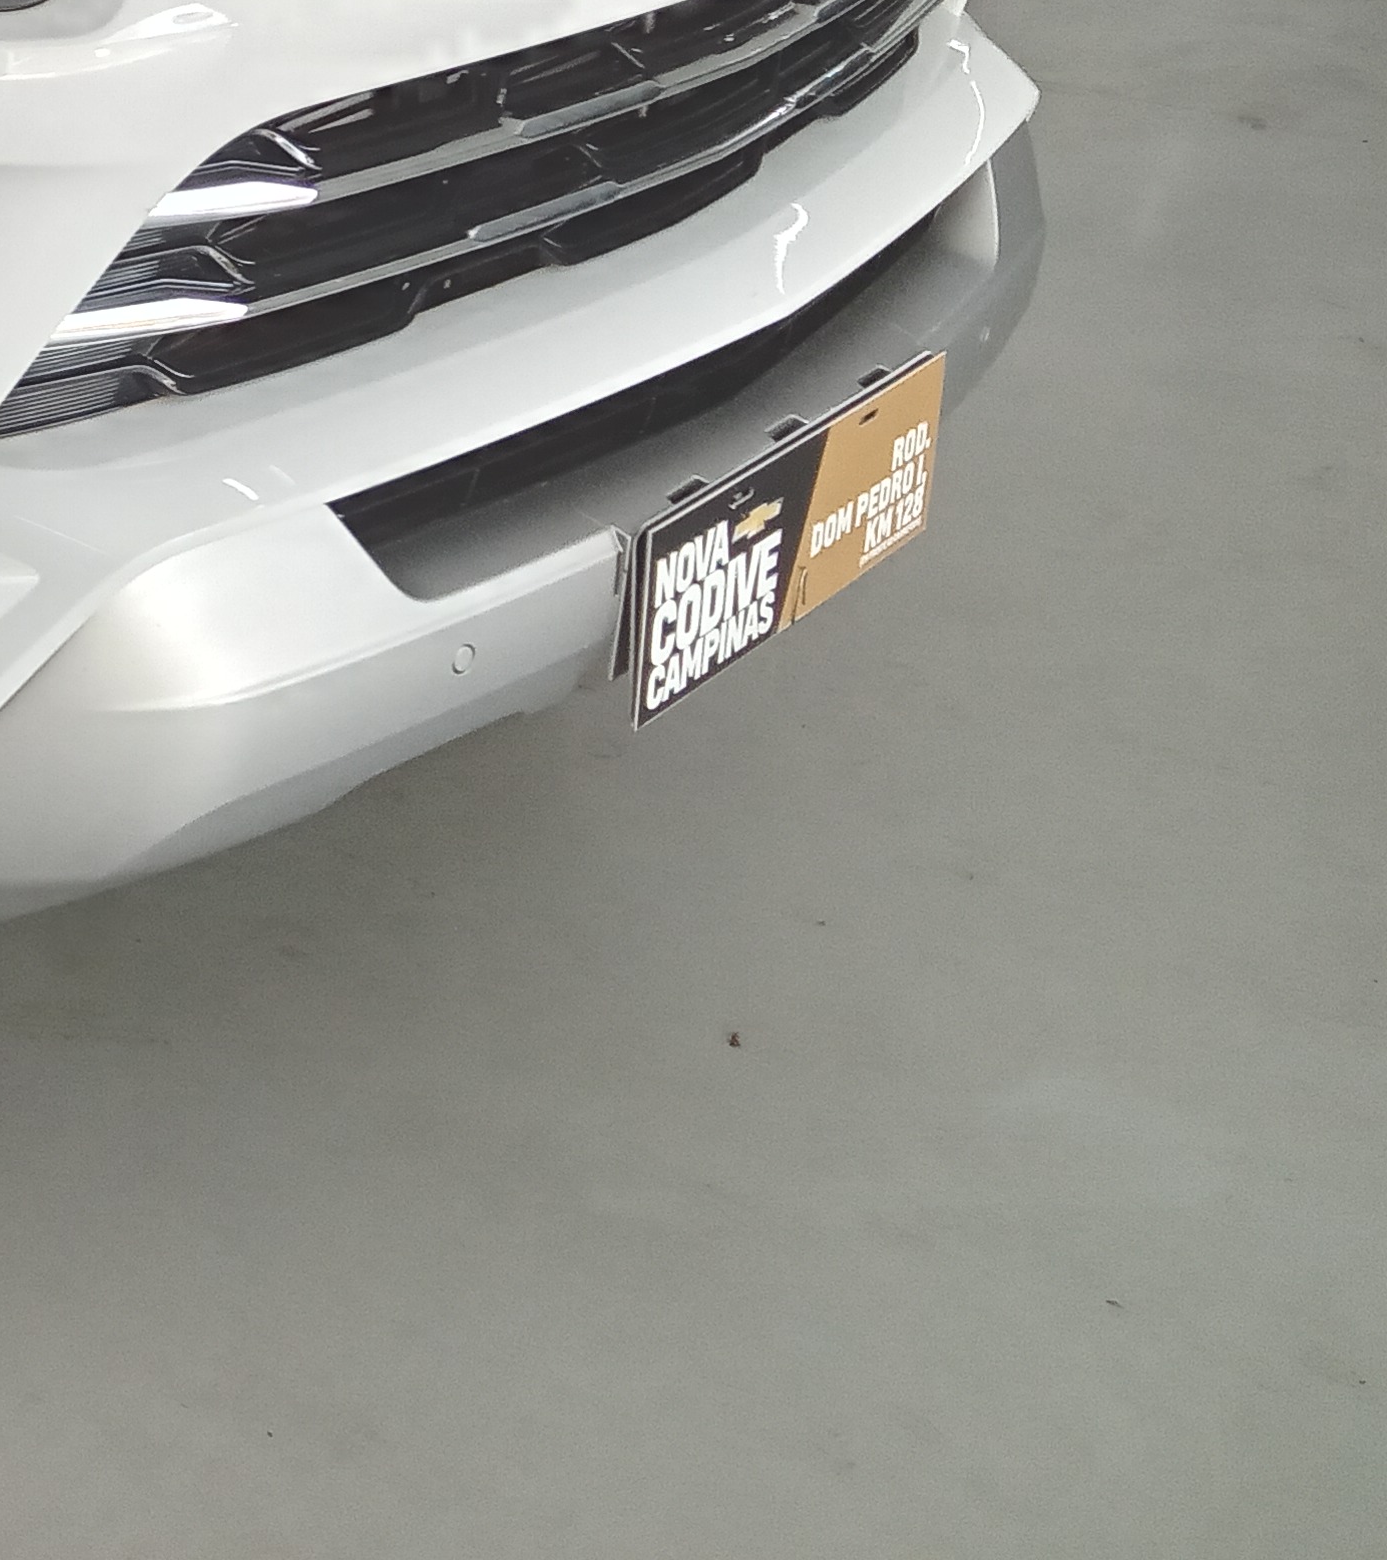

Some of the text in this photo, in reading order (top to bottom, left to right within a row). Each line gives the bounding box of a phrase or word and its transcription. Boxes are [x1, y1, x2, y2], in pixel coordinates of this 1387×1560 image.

[891, 421, 932, 471] ROD.
[810, 500, 855, 558] DOM
[854, 461, 916, 528] PEDRO
[863, 505, 895, 553] KM
[895, 486, 925, 530] 128
[650, 528, 783, 666] CODIVE
[654, 519, 730, 609] NOVA
[646, 591, 776, 710] CAMPINAS
